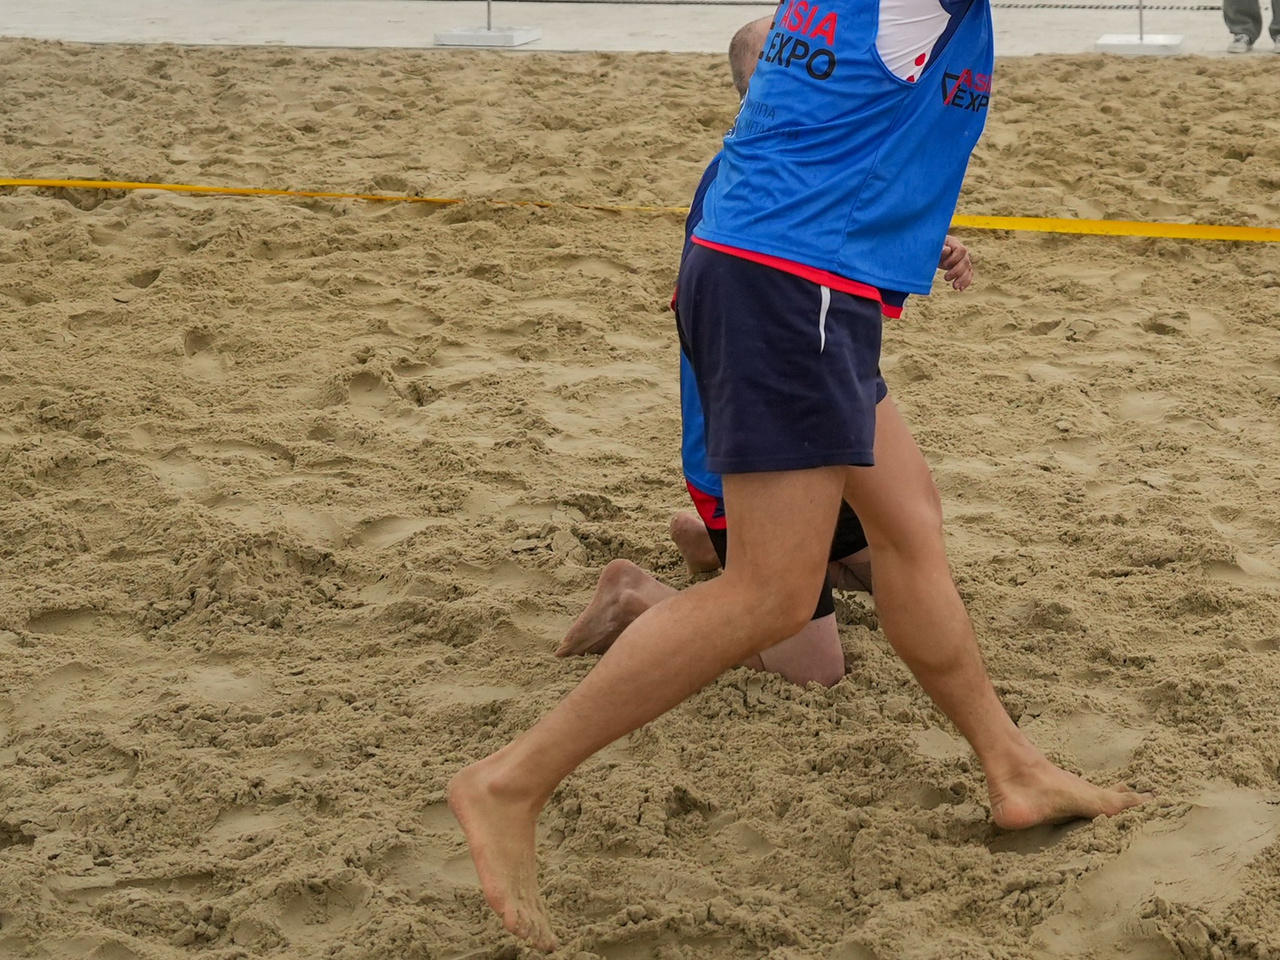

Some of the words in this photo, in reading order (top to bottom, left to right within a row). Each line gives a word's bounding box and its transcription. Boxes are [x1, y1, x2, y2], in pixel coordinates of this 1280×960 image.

[765, 31, 837, 81] EXPO
[956, 68, 992, 94] ASI
[951, 88, 990, 112] EXP
